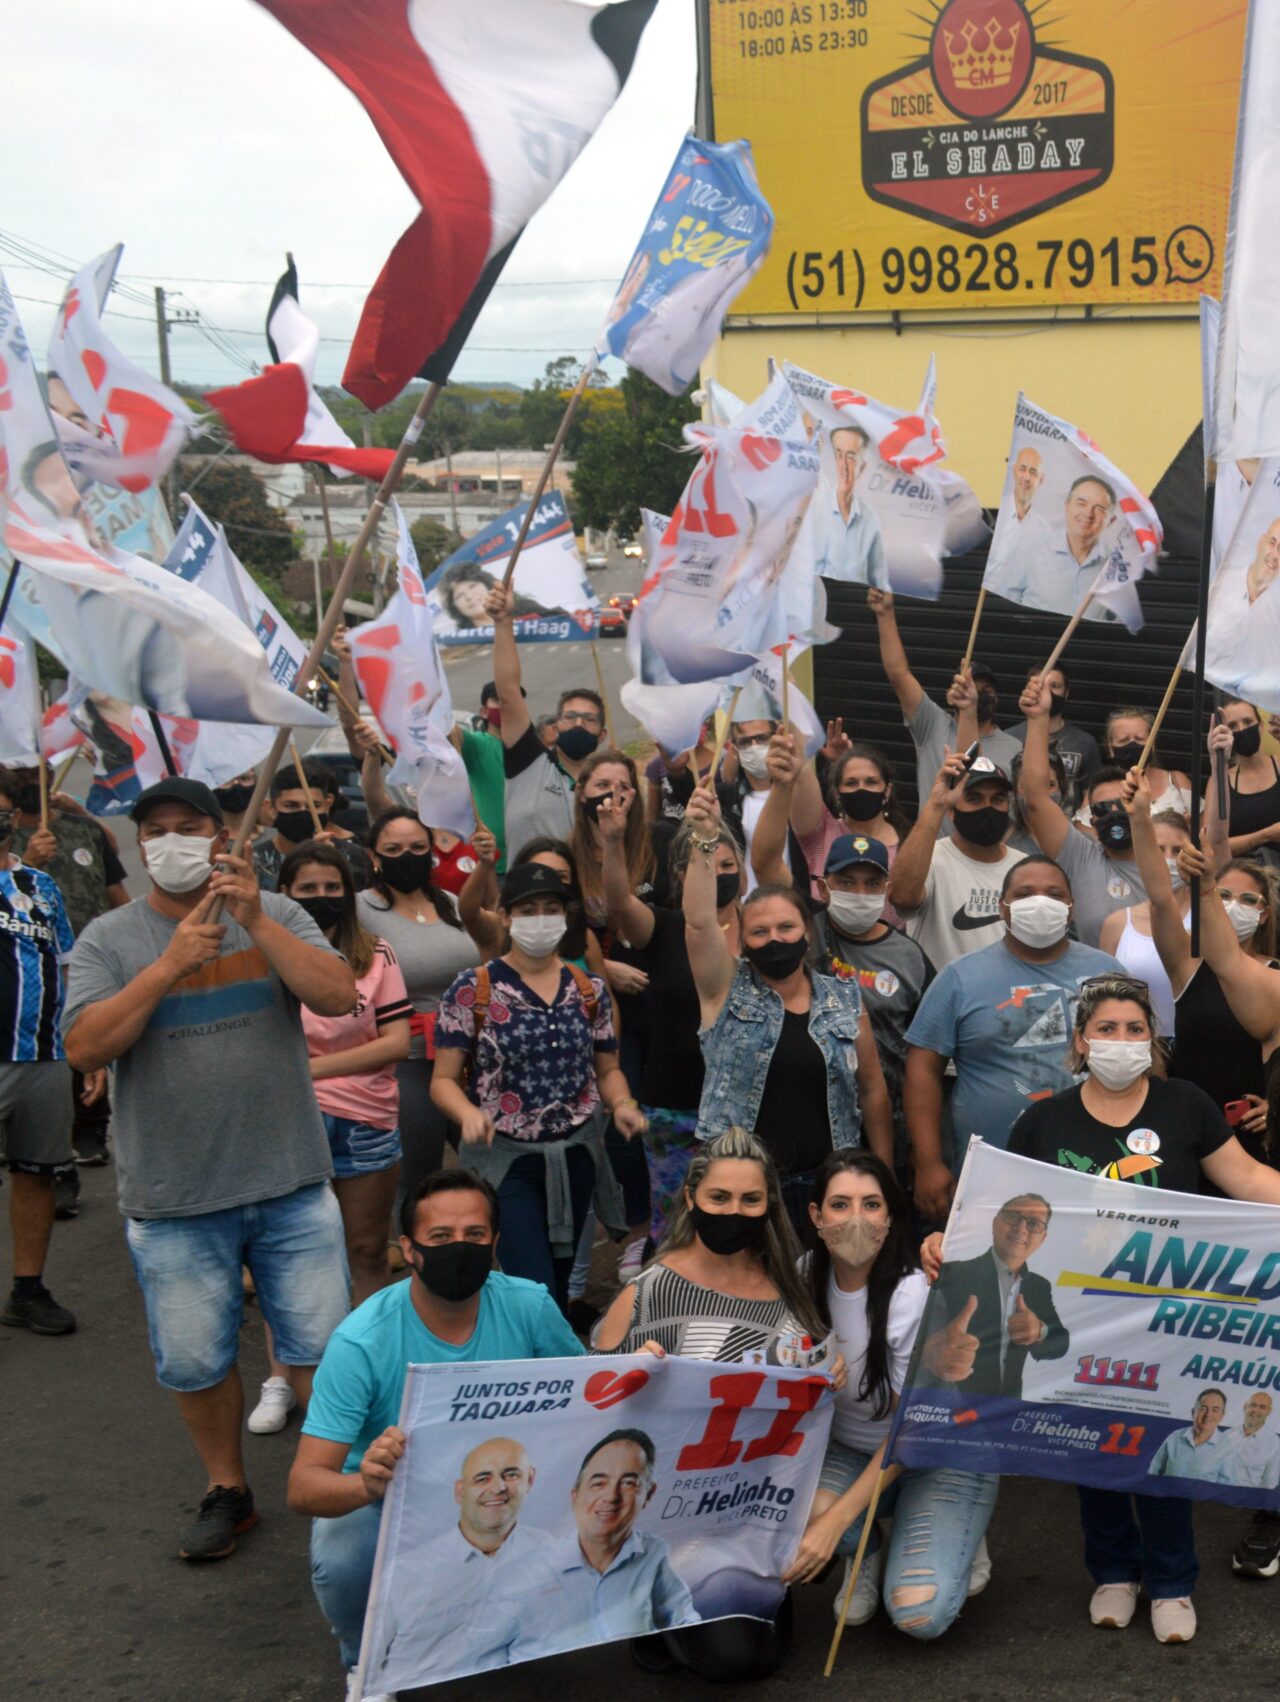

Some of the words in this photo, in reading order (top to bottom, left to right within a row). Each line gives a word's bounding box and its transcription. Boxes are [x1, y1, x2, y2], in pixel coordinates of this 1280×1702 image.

[739, 9, 784, 30] 10:00
[790, 2, 812, 25] ÀS
[819, 0, 868, 22] 13:30
[740, 37, 785, 58] 18:00
[790, 31, 813, 54] ÀS
[819, 28, 868, 51] 23:30
[968, 67, 994, 87] CM
[891, 93, 933, 117] DESDE
[1033, 81, 1067, 106] 2017
[939, 131, 959, 144] CIA
[963, 129, 978, 142] DO
[982, 126, 1028, 141] LANCHE
[891, 151, 929, 179] EL
[947, 138, 1085, 175] SHADAY
[786, 247, 866, 310] (51)
[880, 236, 1158, 295] 99828.7915
[523, 620, 570, 638] Haag
[173, 1017, 251, 1041] CHALLENGE
[1095, 1209, 1180, 1229] VEREADOR
[1073, 1355, 1160, 1391] 11111
[455, 1382, 529, 1401] JUNTOS
[534, 1379, 575, 1395] POR
[449, 1398, 572, 1422] TAQUARA
[676, 1372, 829, 1471] 11
[931, 1406, 951, 1415] POR
[1018, 1411, 1063, 1422] PREFEITO
[1032, 1421, 1100, 1442] Helinho
[1100, 1423, 1146, 1456] 11
[673, 1472, 739, 1491] PREFEITO
[694, 1476, 795, 1516] Helinho
